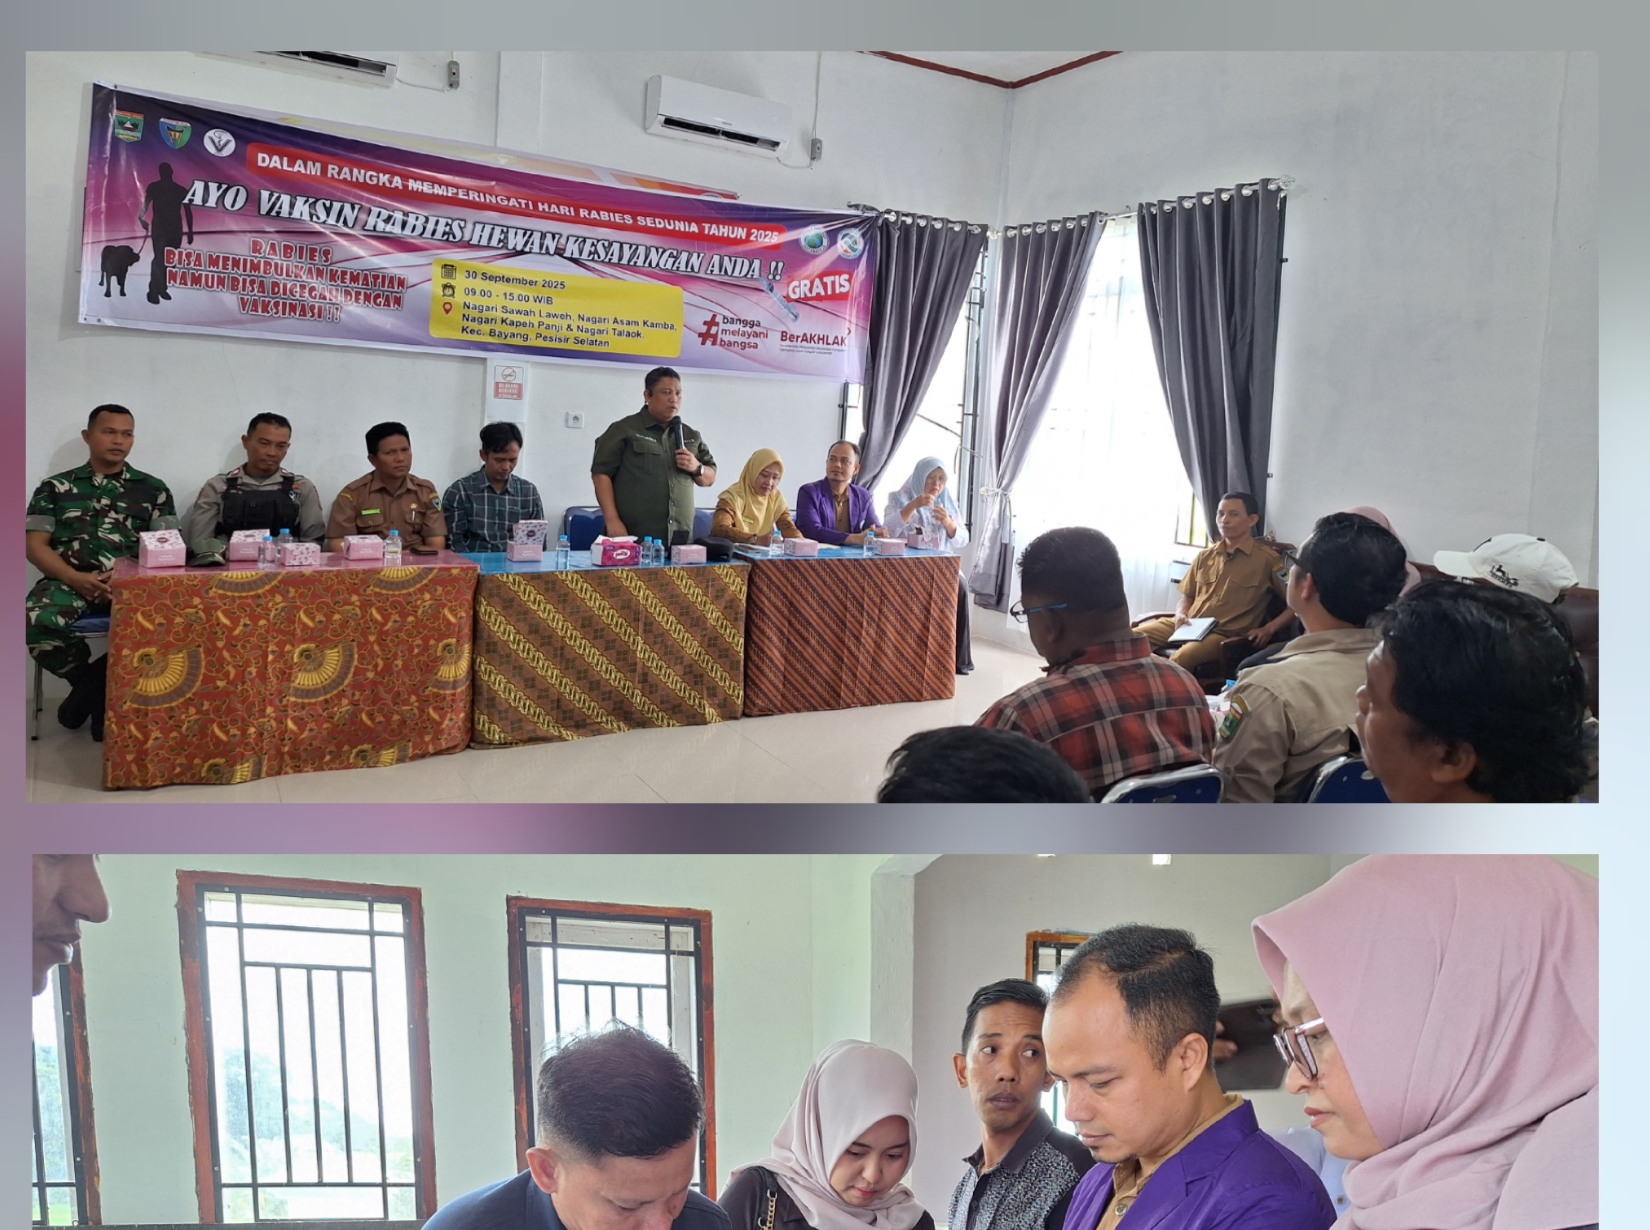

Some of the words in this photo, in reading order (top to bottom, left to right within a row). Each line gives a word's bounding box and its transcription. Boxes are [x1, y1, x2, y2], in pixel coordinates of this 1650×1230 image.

[257, 152, 321, 176] DALAM
[327, 163, 402, 189] RANGKA
[408, 178, 533, 211] MEMPERINGATI
[538, 201, 575, 216] HARI
[579, 208, 632, 225] RABIES
[637, 216, 698, 233] SEDUNIA
[702, 223, 747, 239] TAHUN
[750, 229, 779, 243] 2025
[182, 180, 248, 211] AYO
[258, 189, 361, 228] VAKSIN
[364, 206, 465, 242] RABIES
[470, 221, 560, 255] HEWAN
[563, 236, 705, 274] KESAYANGAN
[706, 255, 761, 279] ANDA
[250, 238, 332, 265] RABIES
[164, 247, 204, 268] BISA
[207, 252, 325, 283] MENIMBULKAN
[328, 264, 407, 292] KEMATIAN
[788, 273, 850, 300] GRATIS
[239, 296, 323, 320] VAKSINASI
[780, 331, 848, 347] BerAKHLAK
